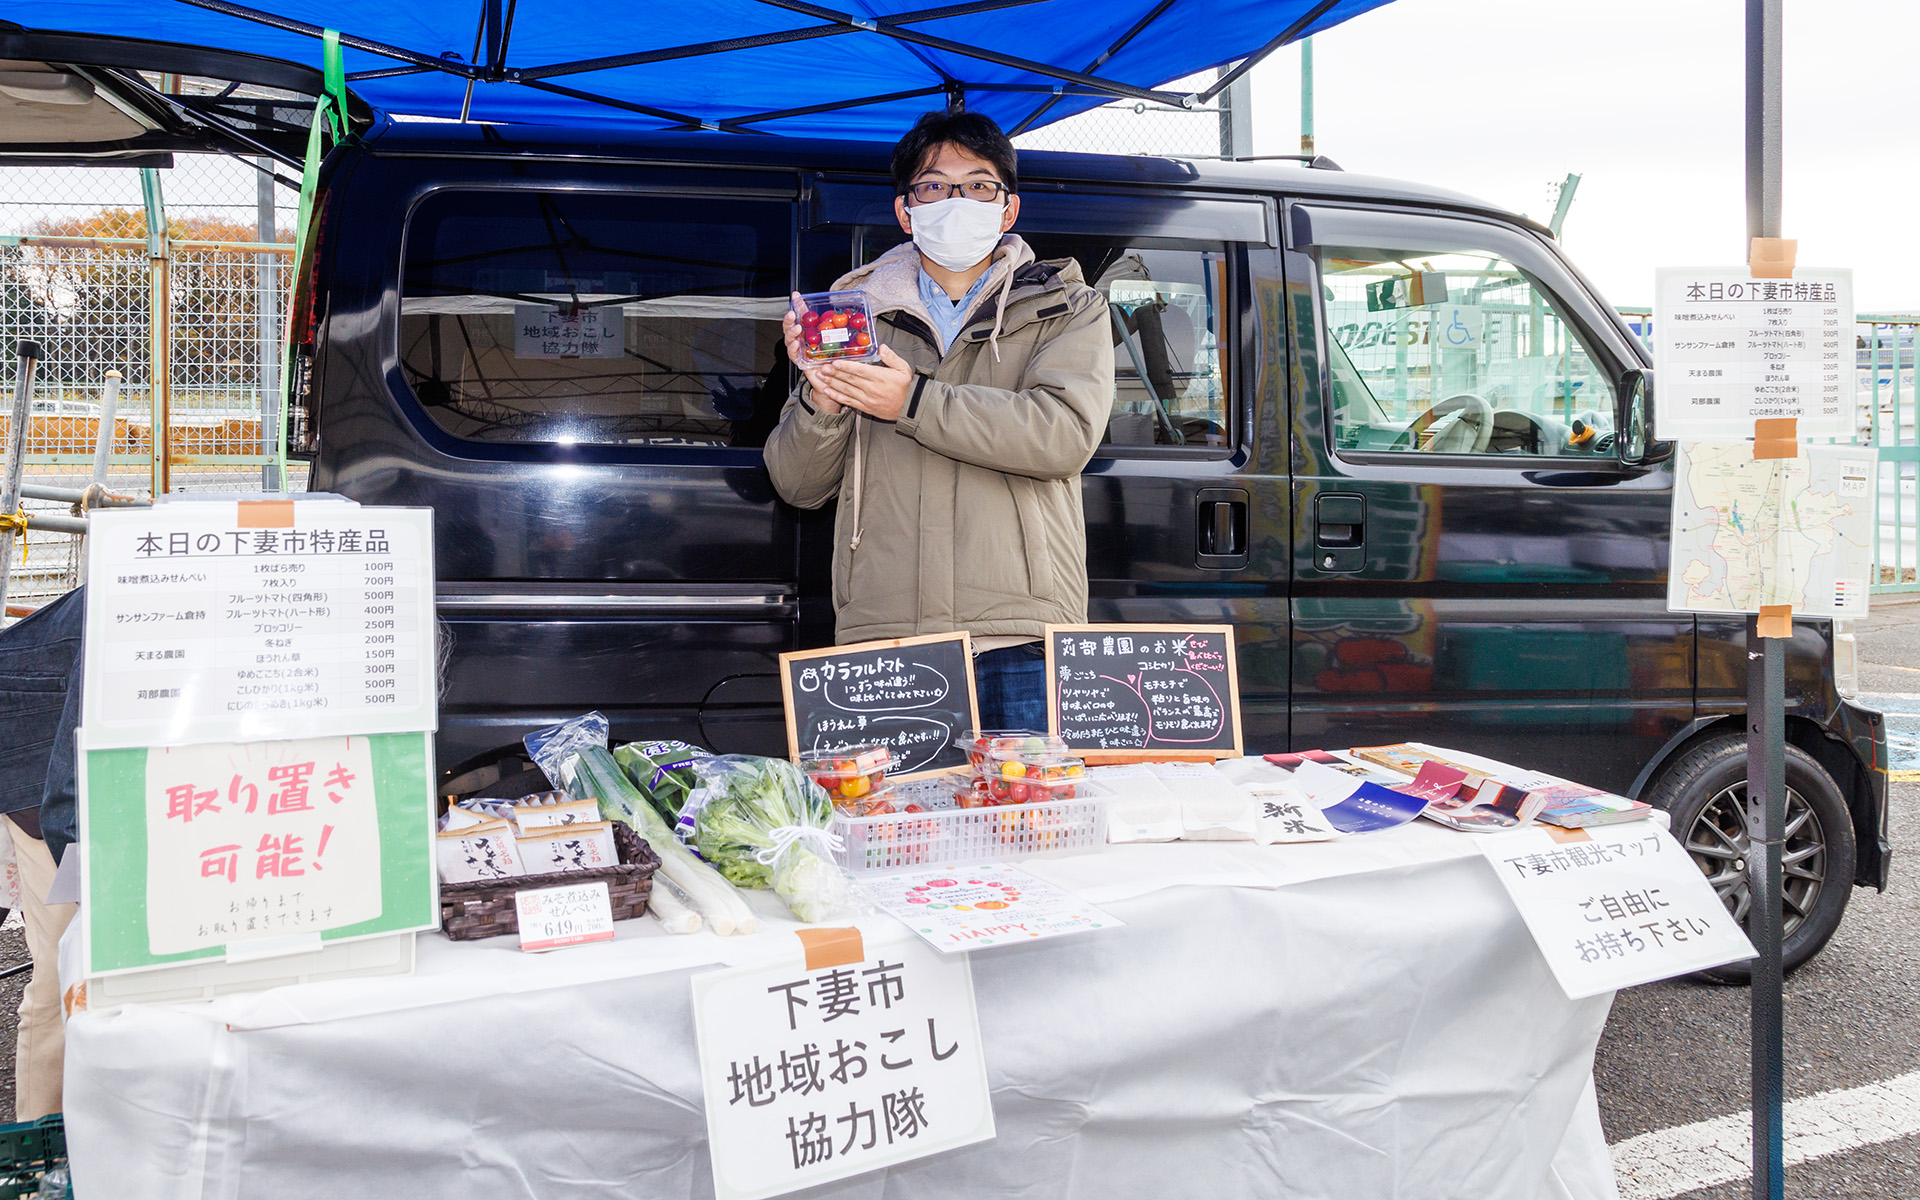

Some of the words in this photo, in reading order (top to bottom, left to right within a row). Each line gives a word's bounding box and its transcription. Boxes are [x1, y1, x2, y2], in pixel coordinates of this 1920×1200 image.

[1686, 281, 1836, 301] 本日の下妻市特産品
[523, 325, 615, 338] 地域おこし
[542, 341, 600, 354] 協力隊
[1842, 482, 1865, 492] MAP
[136, 529, 390, 556] 本日の下妻市特産品
[253, 562, 306, 574] 1枚ばら売り
[364, 562, 395, 572] 100円
[117, 572, 207, 585] 味噌煮込みせんべい
[262, 578, 297, 588] 7枚入り
[364, 576, 395, 586] 700円
[228, 592, 329, 604] フルーツトマト(四角形)
[364, 591, 395, 600] 500円
[116, 610, 206, 623] サンサンファーム倉持
[225, 606, 331, 619] フルーツトマト(ハート形)
[364, 605, 395, 615] 400円
[254, 623, 303, 633] ブロッコリー
[364, 620, 395, 630] 250円
[264, 637, 293, 648] 冬ねぎ
[364, 635, 395, 644] 200円
[1061, 635, 1188, 657] 苅部農園のお米
[134, 649, 185, 662] 天まる農園
[256, 652, 301, 664] ほうれん草
[364, 649, 395, 659] 150円
[237, 666, 319, 679] ゆめごこち(2合米)
[364, 664, 395, 674] 300円
[820, 657, 905, 680] カラフルトマト
[1137, 661, 1175, 671] コシヒカリ
[1059, 665, 1097, 682] 夢ごこち
[236, 682, 319, 695] こしひかり(1kg米)
[364, 679, 395, 689] 500円
[1144, 678, 1188, 690] モチモチで
[137, 688, 182, 700] 苅部農園
[364, 694, 395, 704] 500円
[1062, 688, 1110, 699] ツヤツヤで
[1061, 701, 1116, 711] 甘味が口の中
[1153, 705, 1220, 719] バランスが最高で
[817, 715, 868, 733] ほうれん草
[165, 761, 357, 823] 取り置き
[1262, 802, 1326, 834] 新米
[199, 824, 334, 884] 可能!
[1504, 833, 1662, 879] 下妻市観光マップ
[230, 891, 305, 913] お帰りまで
[541, 888, 601, 906] みそ煮込み
[549, 903, 597, 917] せんべい
[1578, 888, 1670, 923] ご自由に
[198, 907, 334, 937] お取り置きできます
[949, 923, 1028, 942] HAPPY
[1574, 918, 1711, 963] お持ち下さい
[767, 960, 905, 1030] 下妻市
[726, 1018, 959, 1108] 地域おこし
[785, 1086, 929, 1170] 協力隊
